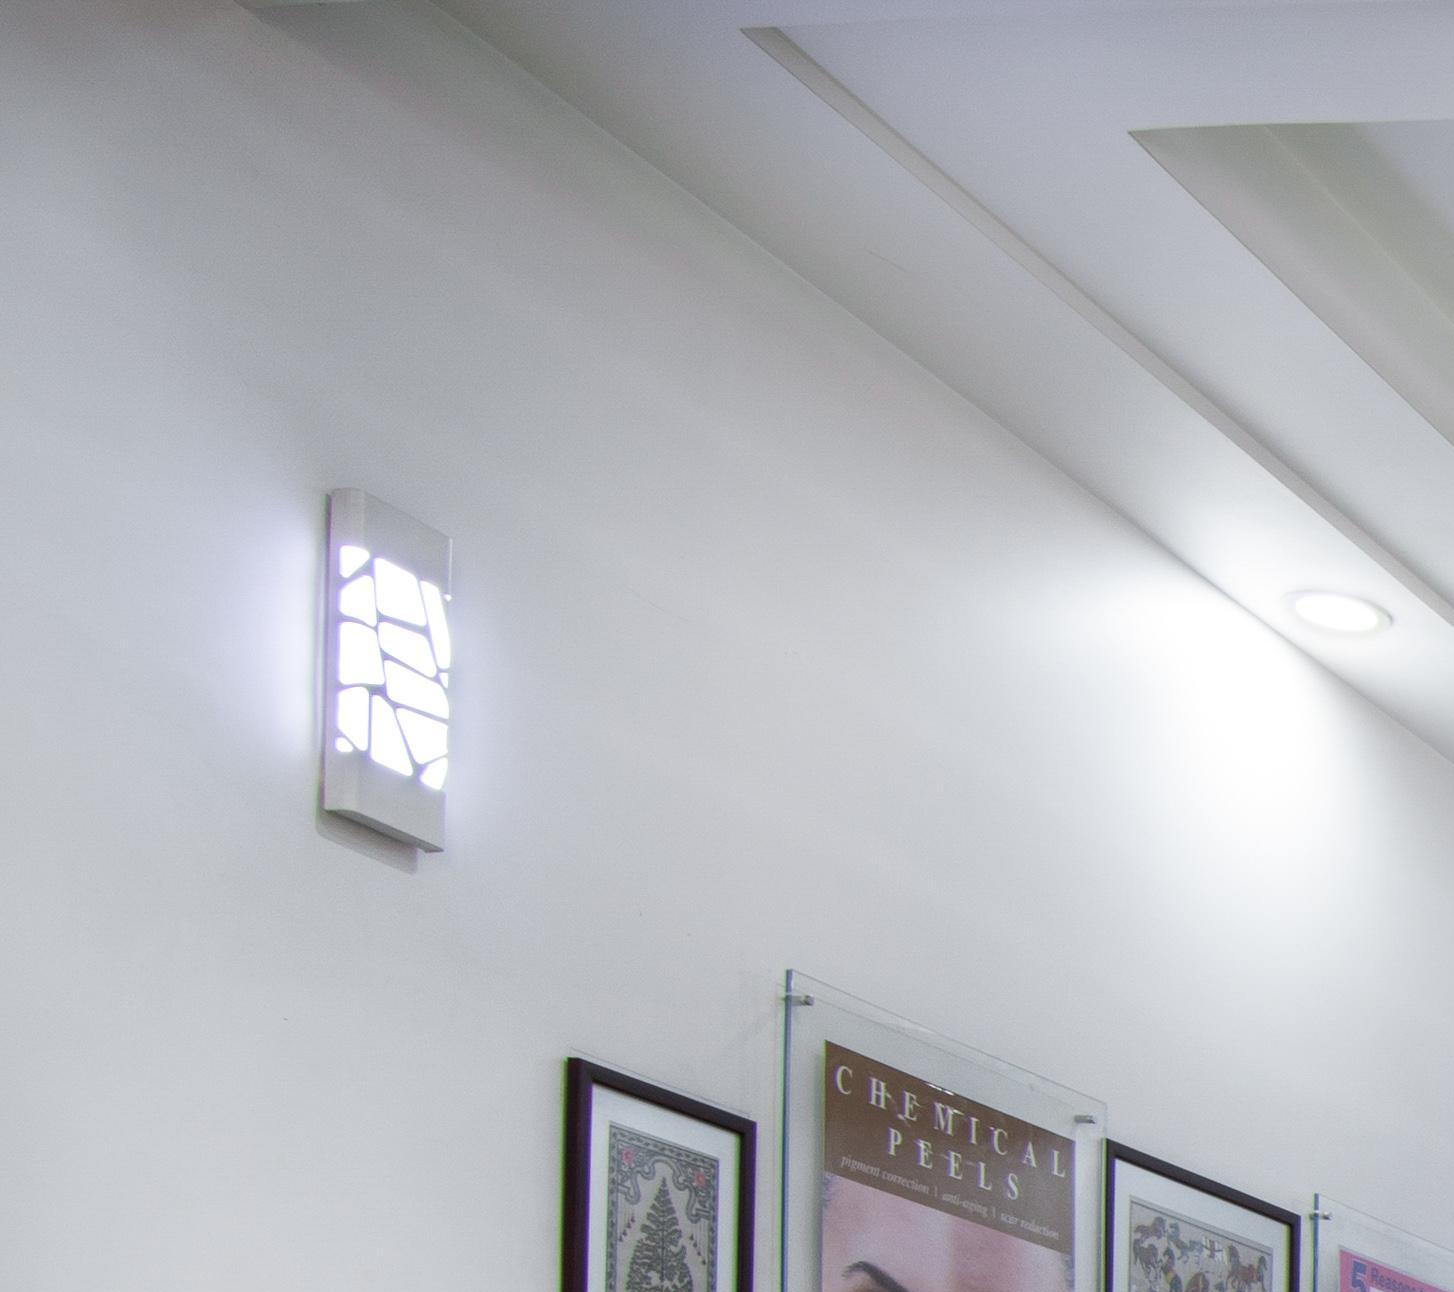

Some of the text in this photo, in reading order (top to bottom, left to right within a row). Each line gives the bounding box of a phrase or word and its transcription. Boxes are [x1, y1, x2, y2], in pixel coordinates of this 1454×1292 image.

[835, 1065, 1065, 1177] CHEMICAL
[888, 1127, 1018, 1200] PEELS
[840, 1154, 1059, 1240] pigment correction anti-aging scar reduction
